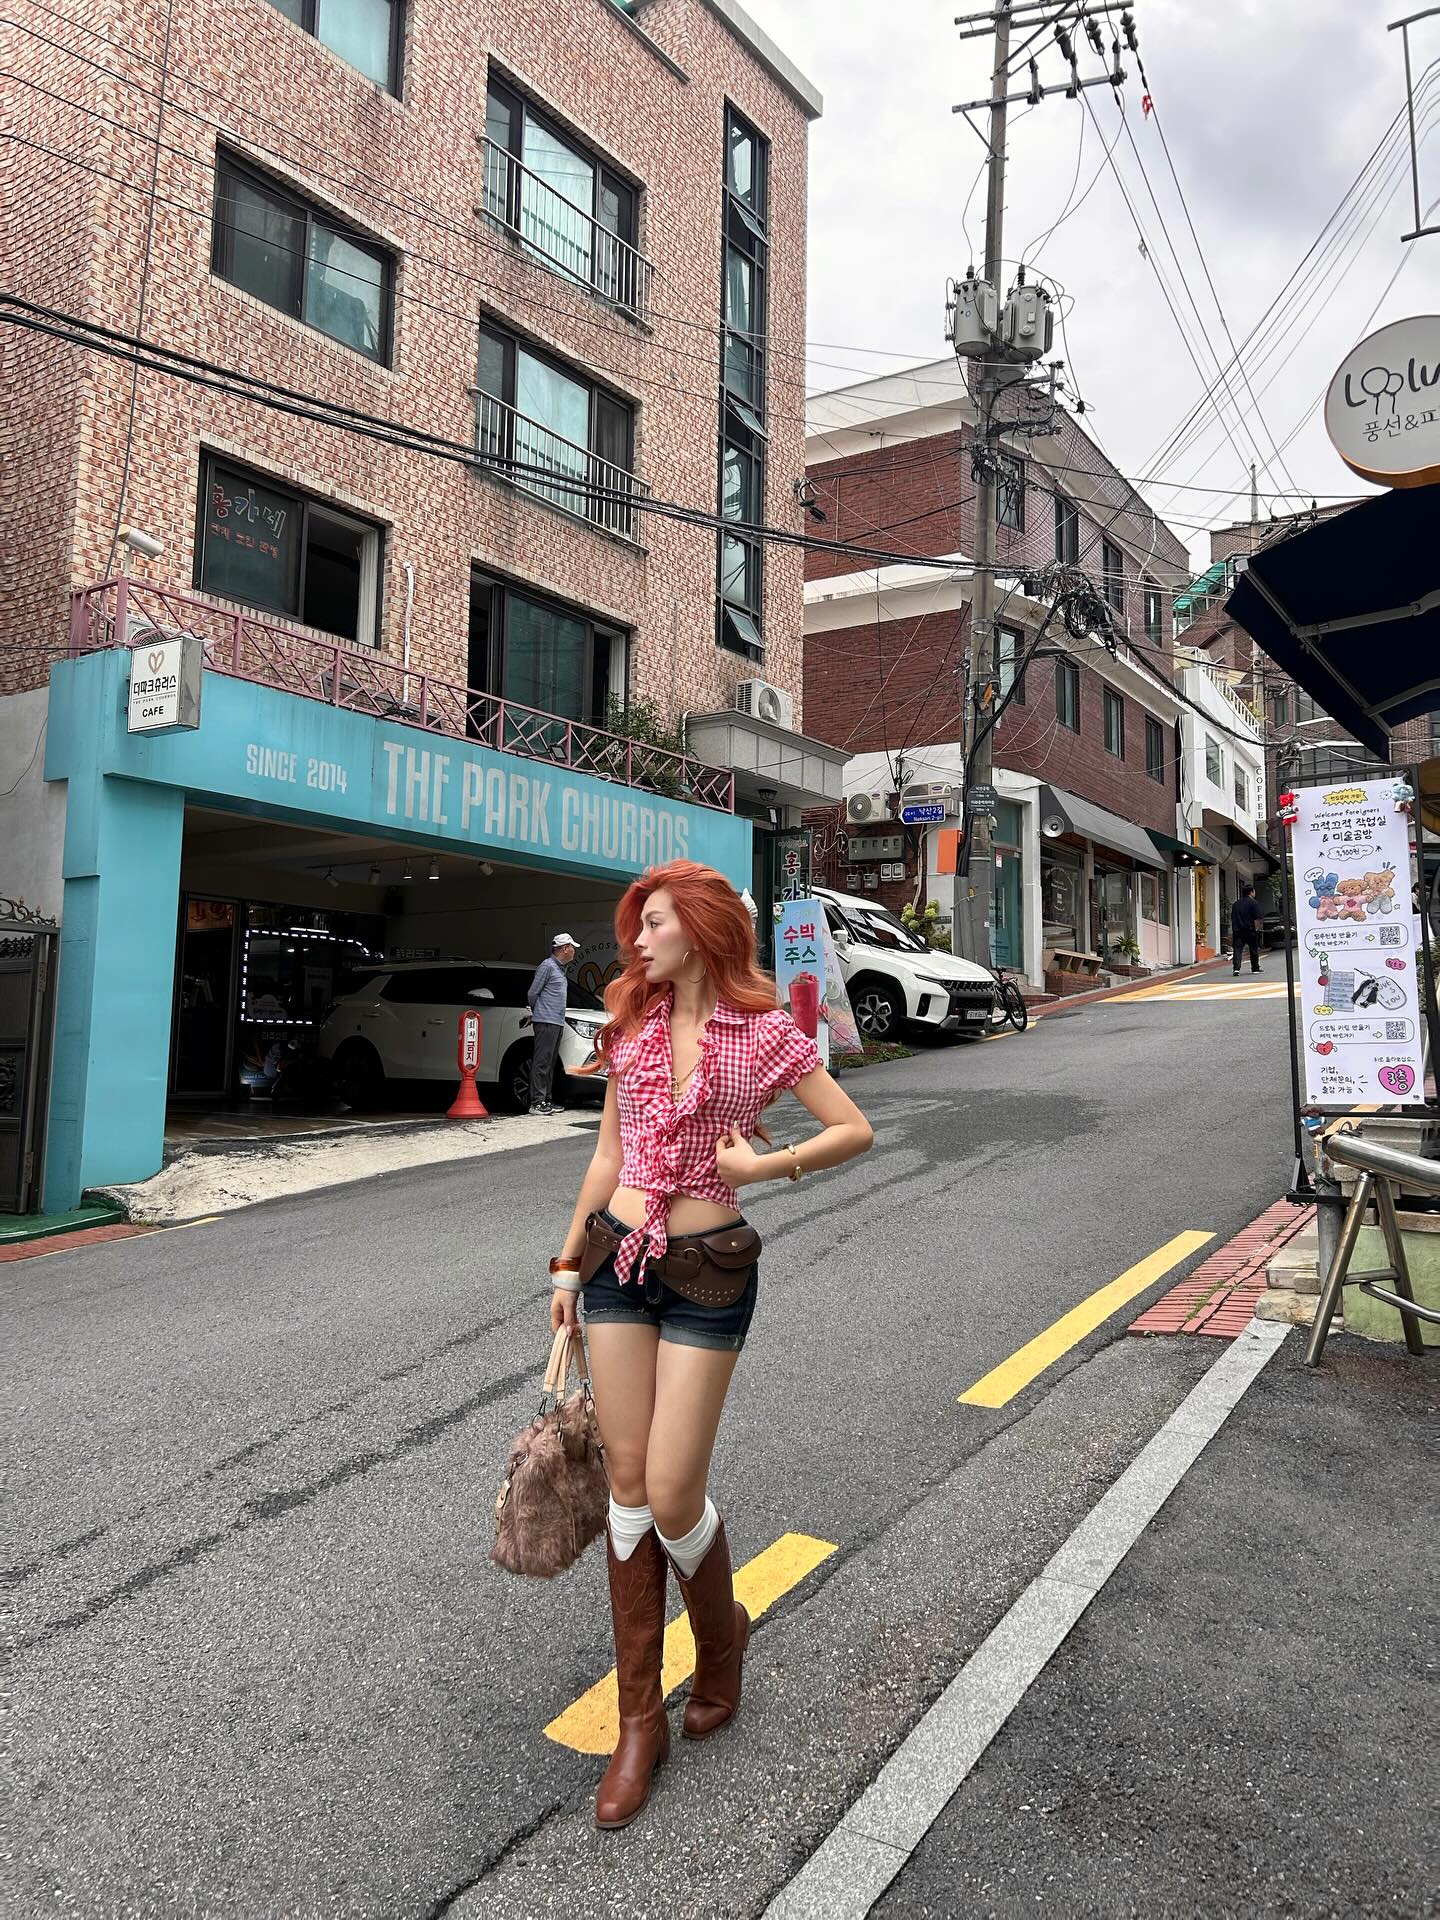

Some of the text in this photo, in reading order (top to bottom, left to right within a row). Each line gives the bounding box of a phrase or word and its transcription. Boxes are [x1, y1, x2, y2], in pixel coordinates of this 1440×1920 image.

[142, 705, 164, 718] CAFE
[246, 743, 348, 794] SINCE 2014
[1255, 767, 1264, 819] COFFEE
[383, 741, 689, 866] THE PARK CHURROS
[918, 805, 943, 815] 낙산2길
[1310, 815, 1387, 832] 끄적끄적 작업실
[1322, 830, 1373, 843] & 미술공방
[783, 922, 816, 944] 수박
[567, 942, 610, 973] CHURROS
[784, 945, 817, 965] 주스
[1384, 994, 1401, 1006] YOU
[466, 1041, 475, 1062] 금지
[1320, 1066, 1339, 1075] 기업,
[1387, 1068, 1408, 1091] 3층
[1321, 1076, 1356, 1085] 단체문의,
[1338, 1086, 1353, 1094] 가능
